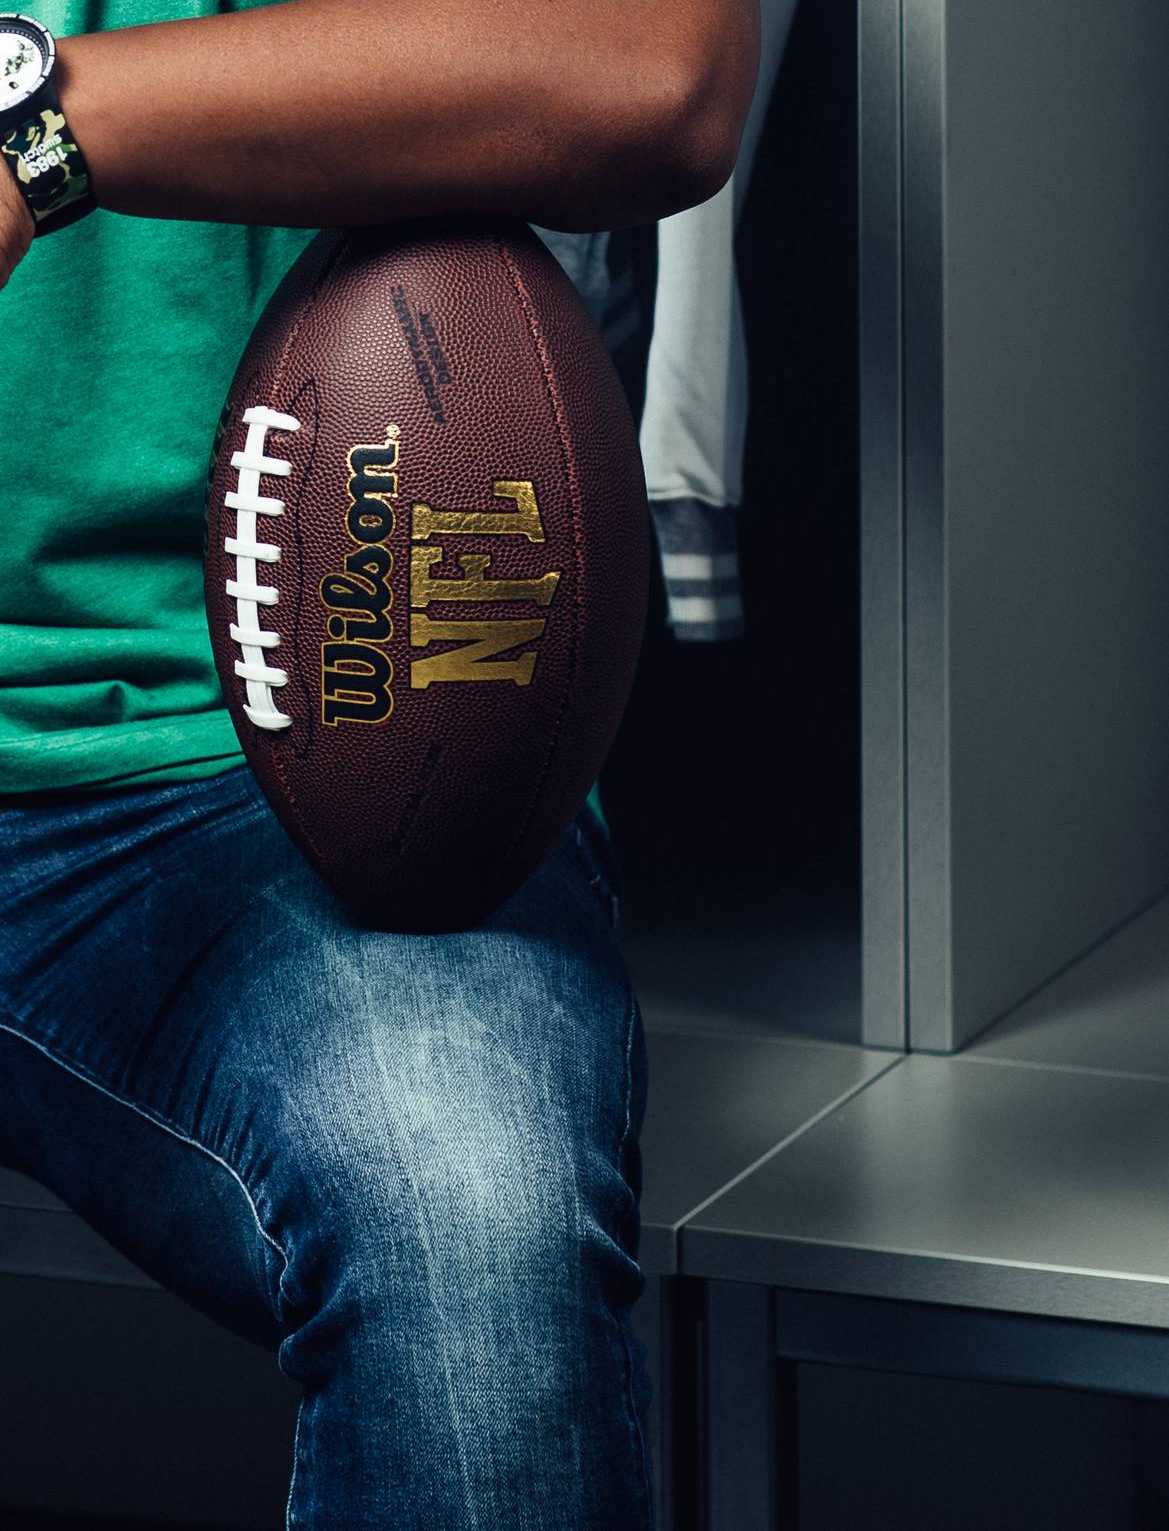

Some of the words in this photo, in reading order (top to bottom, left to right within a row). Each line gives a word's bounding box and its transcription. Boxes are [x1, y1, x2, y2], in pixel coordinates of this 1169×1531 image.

[23, 133, 63, 162] swatch
[319, 437, 400, 727] Wilson
[410, 480, 562, 690] NFL
